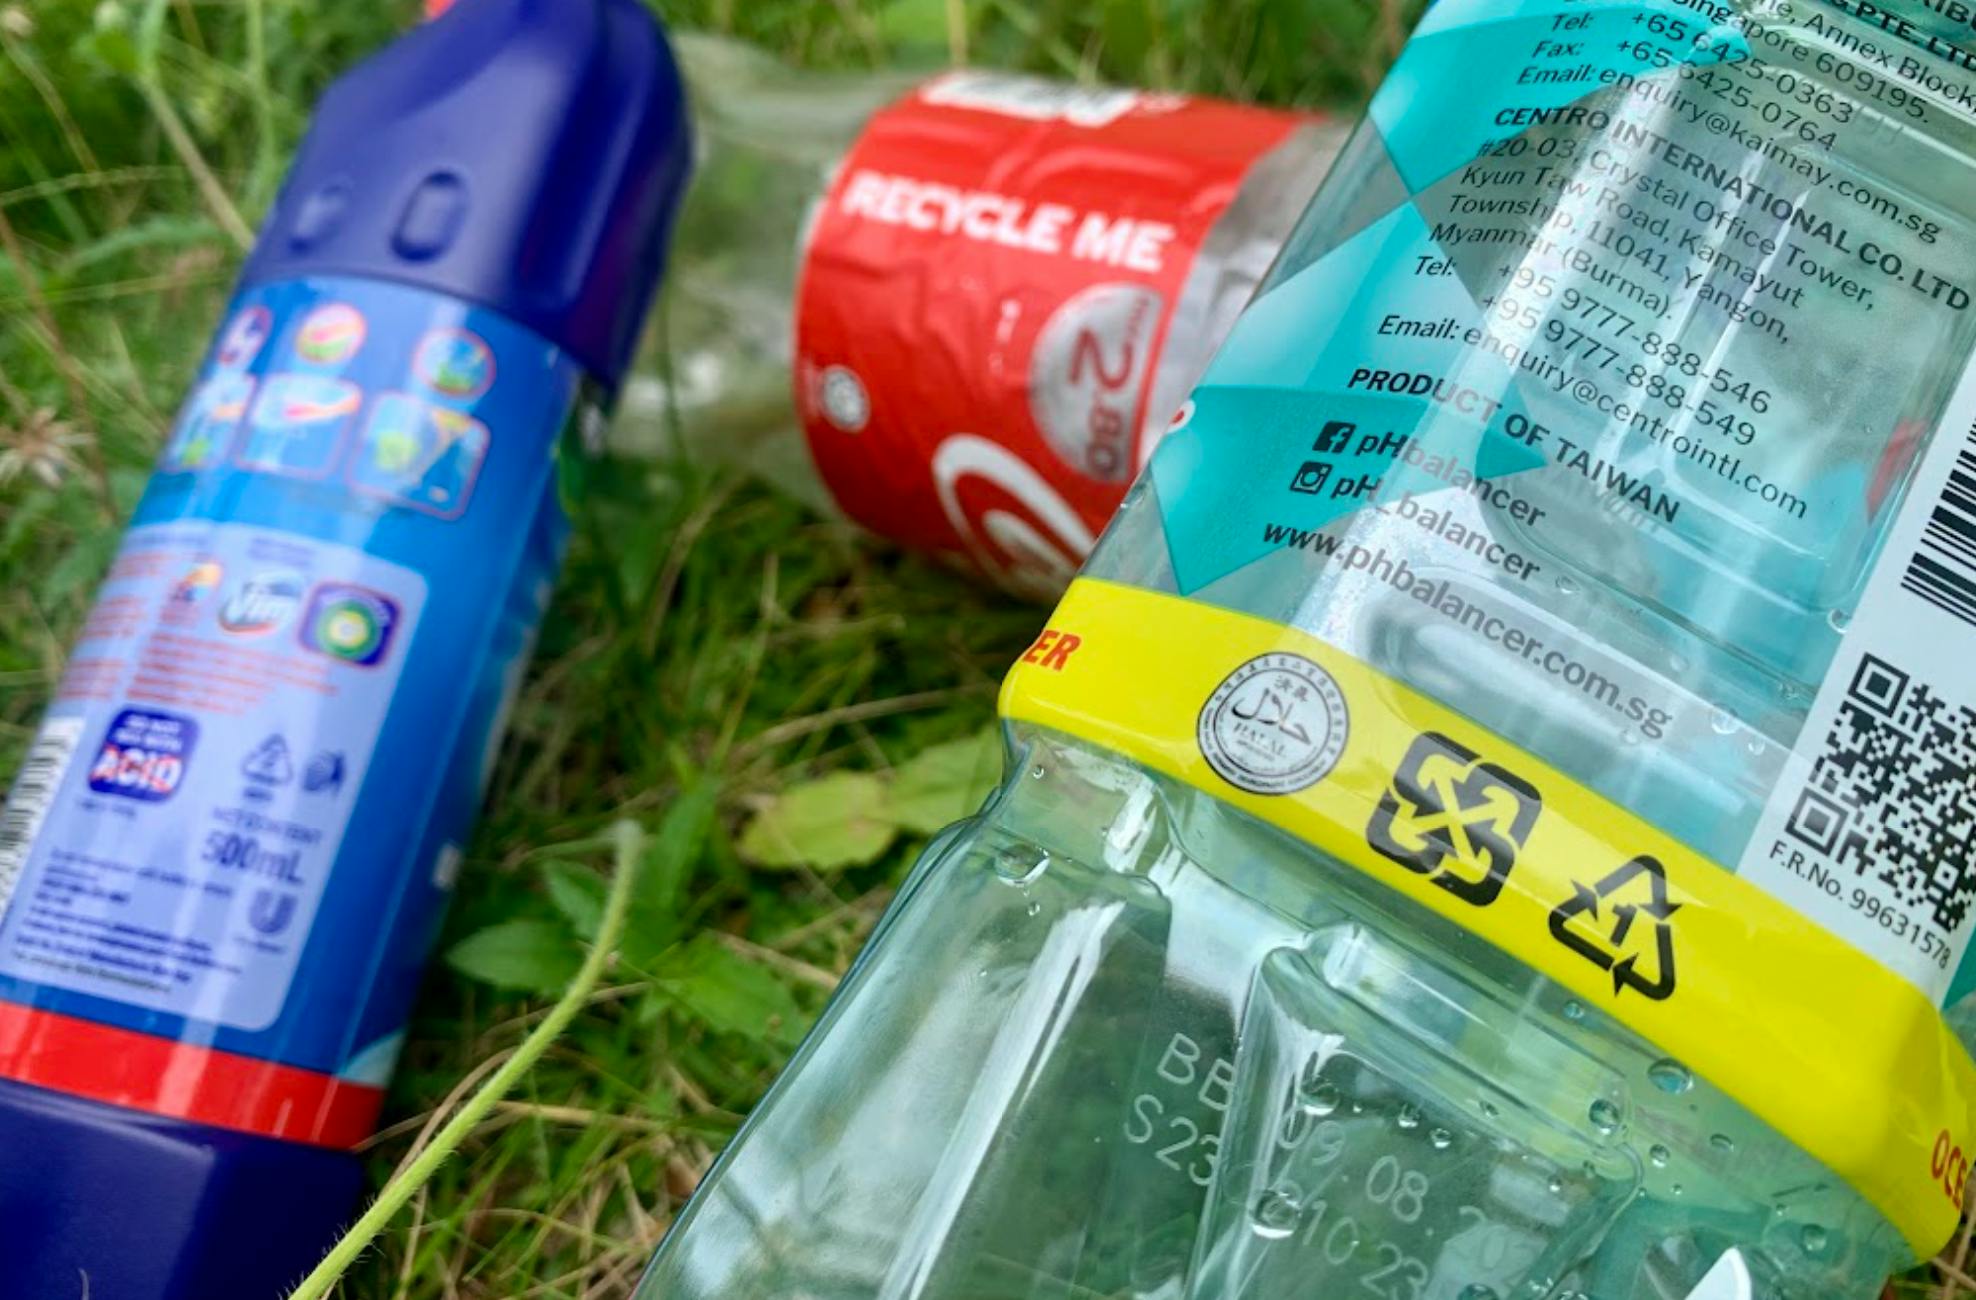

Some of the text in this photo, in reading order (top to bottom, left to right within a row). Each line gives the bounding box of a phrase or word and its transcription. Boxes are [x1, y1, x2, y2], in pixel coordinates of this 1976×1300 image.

[1531, 39, 1838, 152] Fax: +65 6425-0764
[1551, 12, 1854, 124] Tel: +65 6425-0363
[1803, 13, 1894, 68] Annex
[1815, 52, 1929, 124] 609195.
[1493, 106, 1611, 131] CENTRO
[1611, 119, 1852, 254] INTERNATIONAL
[1858, 241, 1905, 281] CO.
[1516, 64, 1942, 245] Email: enquiry@kaimay.com.sg
[842, 169, 1176, 274] RECYCLE ME
[1428, 221, 1673, 321] Myanmar (Burma).
[1449, 194, 1789, 345] Township, 11041, Yangon,
[1460, 166, 1806, 309] Kyun Taw Road, Kamayut
[1475, 136, 1874, 311] #20-03, Crystal Office Tower,
[1413, 254, 1772, 415] Tel: +95 9777-888-546
[1482, 295, 1757, 446] +95 9777-888-549
[1347, 368, 1680, 523] PRODUCT OF TAIWAN
[1355, 430, 1547, 528] pHbalancer
[1377, 314, 1808, 519] Email: enquiry@centrointl.com
[1330, 473, 1541, 581] pH_balancer
[1263, 521, 1673, 740] www.phbalancer.com.sg
[89, 744, 183, 793] ACID
[1847, 887, 1952, 969] 99631578
